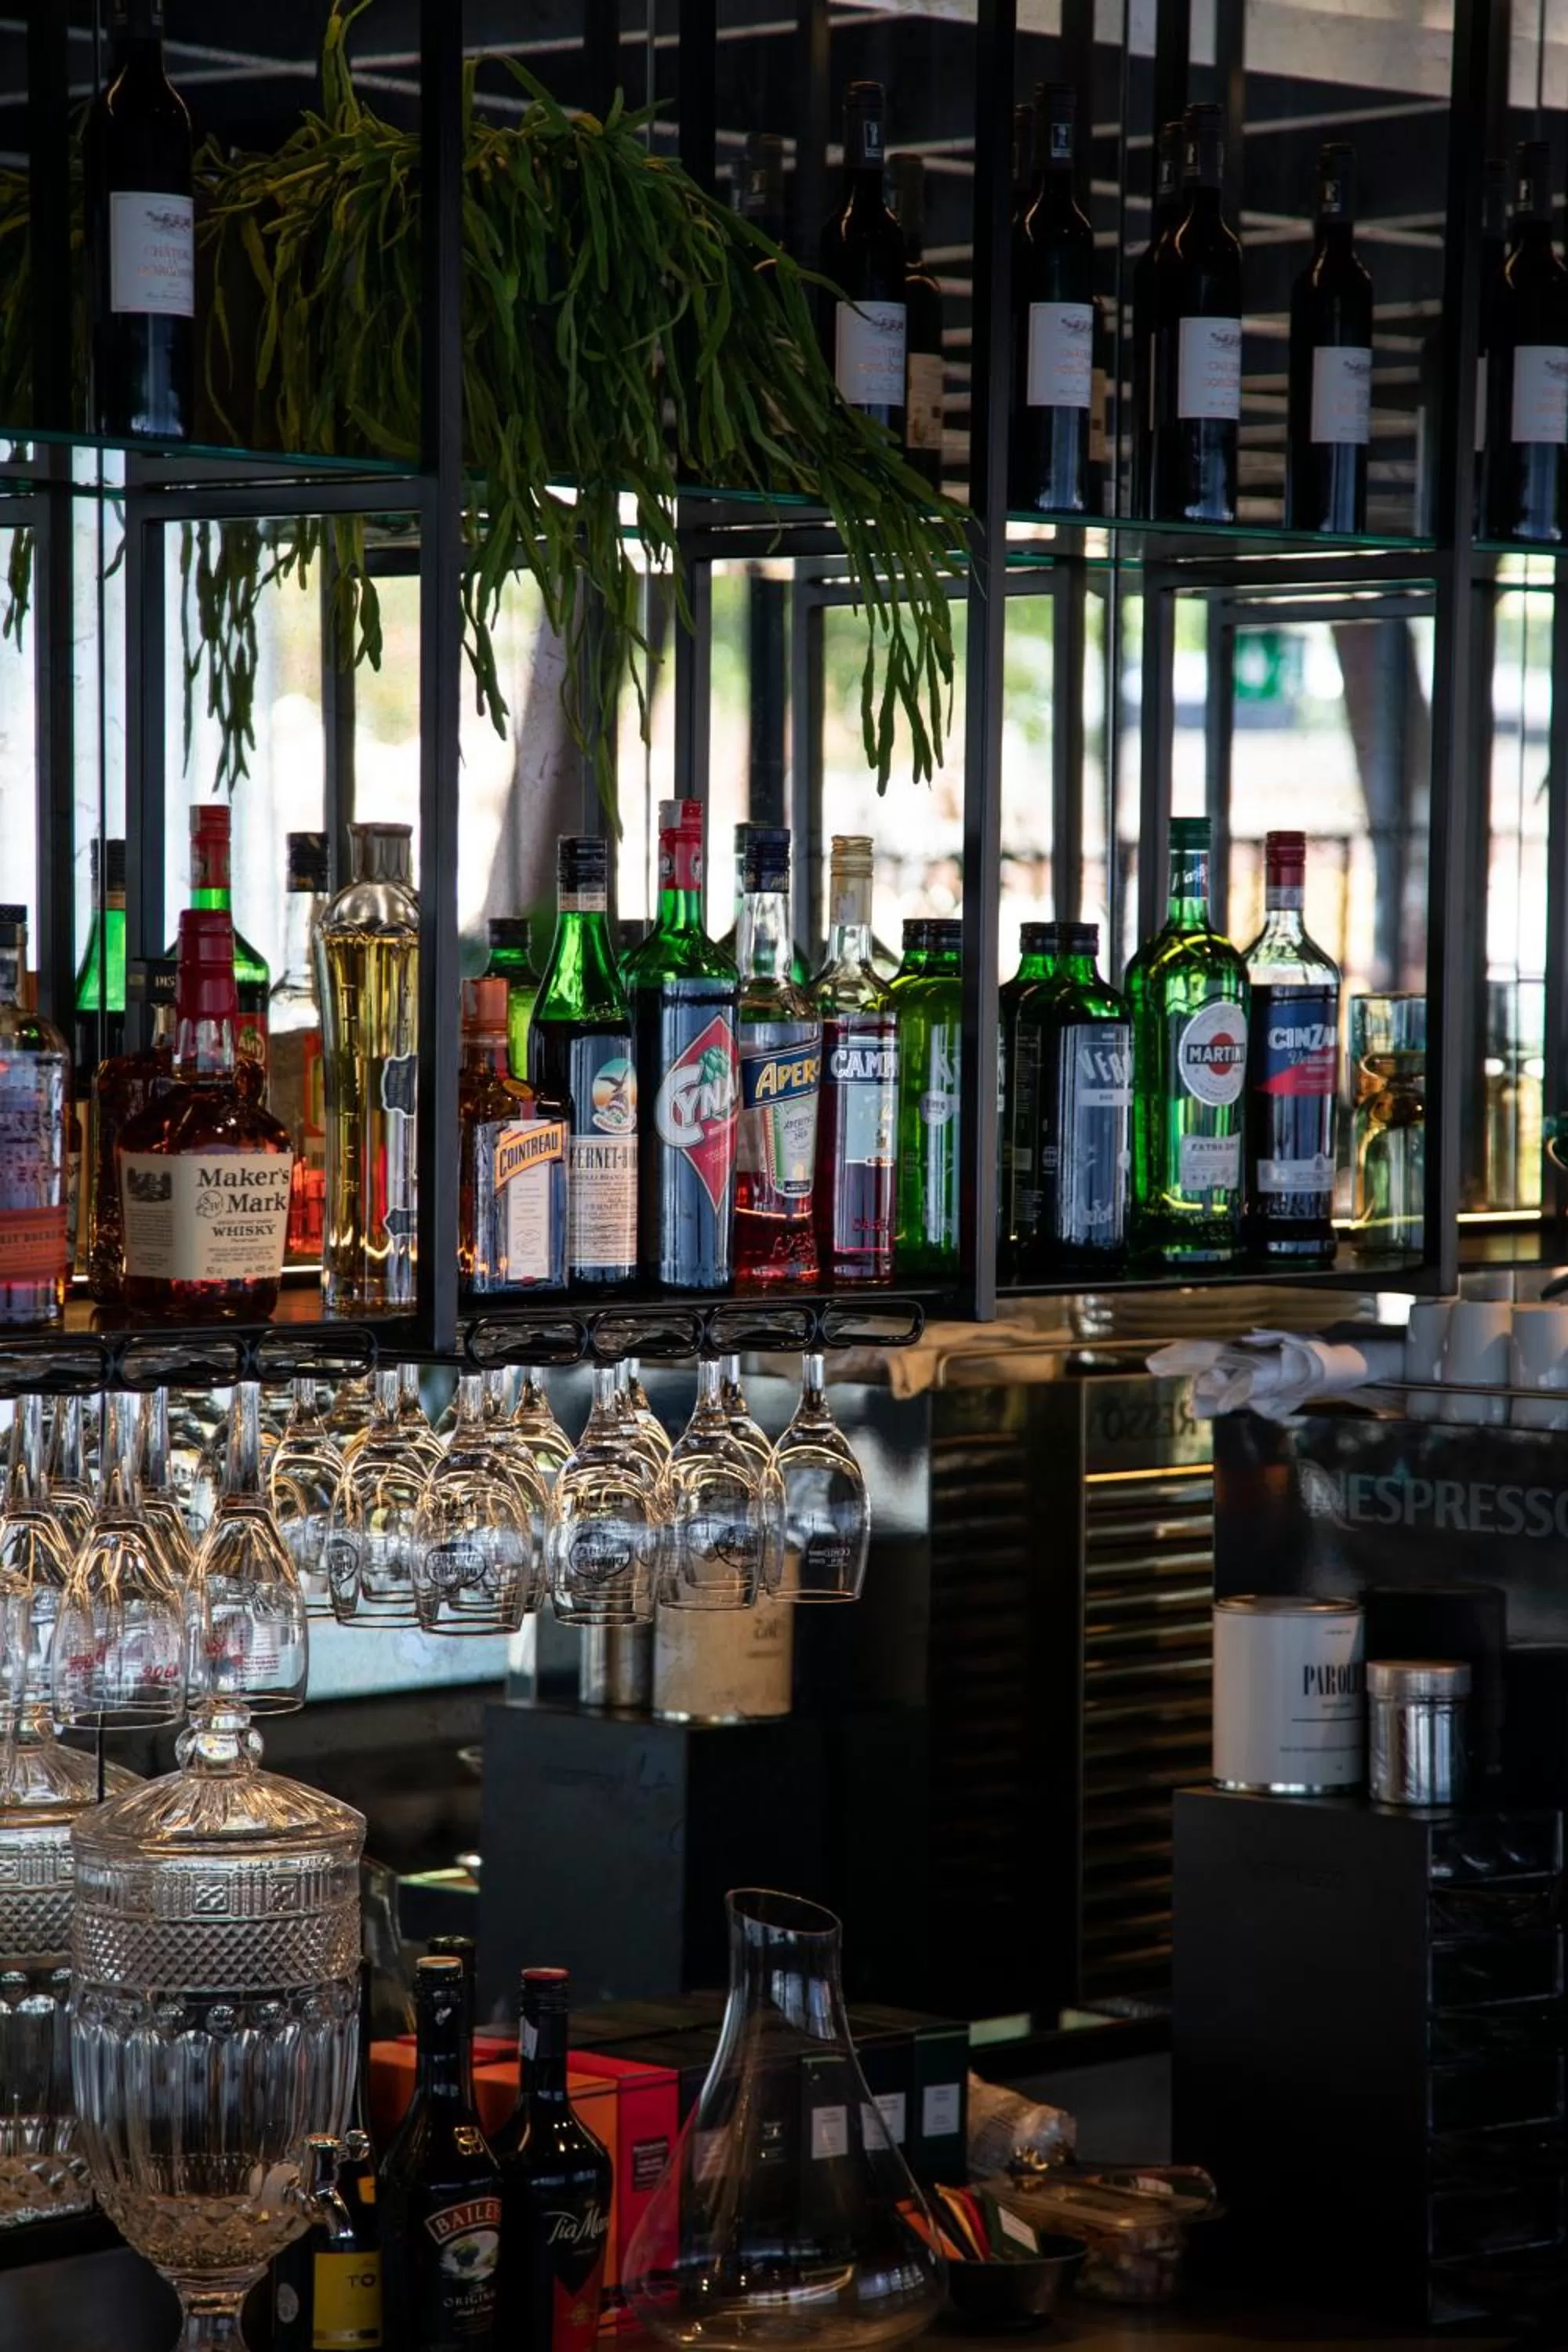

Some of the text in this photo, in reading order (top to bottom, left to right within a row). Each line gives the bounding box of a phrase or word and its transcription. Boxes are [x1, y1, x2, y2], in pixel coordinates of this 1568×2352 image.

[499, 1131, 558, 1178] COINTREAU
[197, 1167, 289, 1188] Maker's
[226, 1192, 287, 1214] Mark
[212, 1224, 277, 1236] WHISKY
